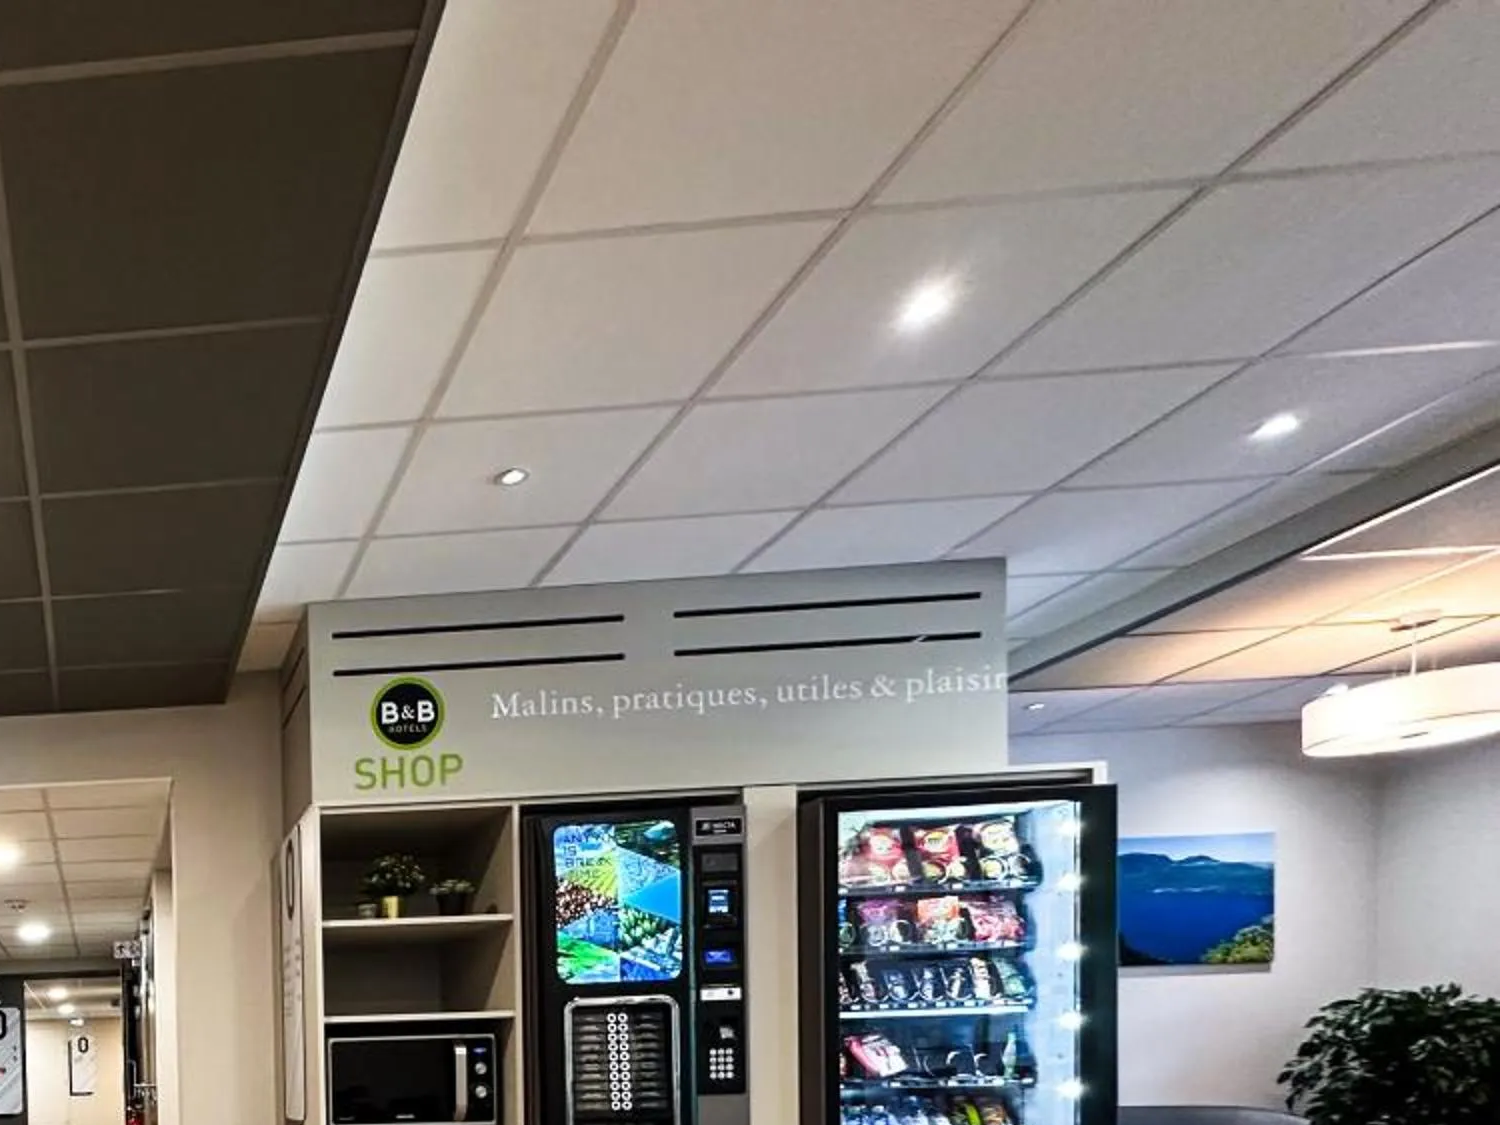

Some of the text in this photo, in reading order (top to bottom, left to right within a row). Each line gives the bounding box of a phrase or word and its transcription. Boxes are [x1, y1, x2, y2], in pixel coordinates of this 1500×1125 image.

[491, 689, 604, 719] Malins,
[611, 683, 768, 719] pratiques,
[777, 674, 863, 703] utiles
[870, 674, 896, 698] &
[381, 700, 435, 725] B&B
[355, 753, 463, 790] SHOP
[77, 1036, 89, 1053] 0
